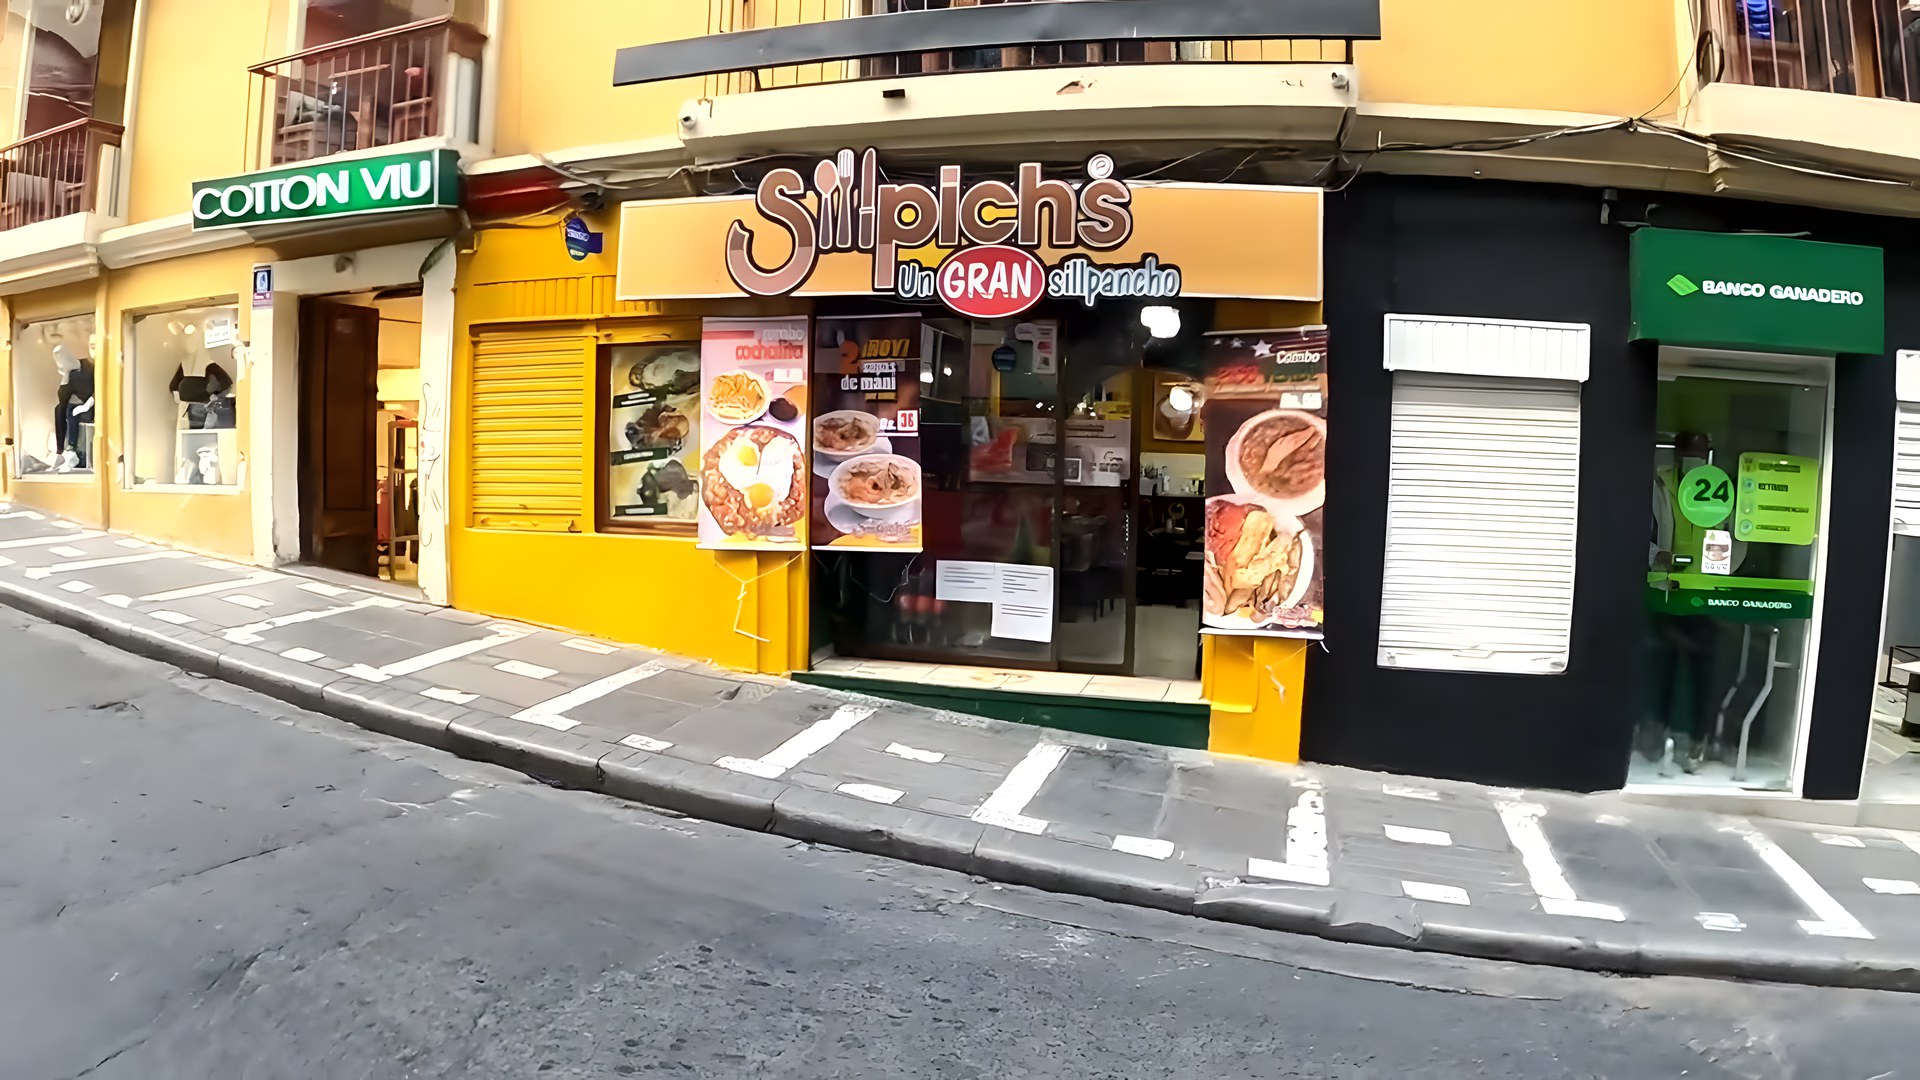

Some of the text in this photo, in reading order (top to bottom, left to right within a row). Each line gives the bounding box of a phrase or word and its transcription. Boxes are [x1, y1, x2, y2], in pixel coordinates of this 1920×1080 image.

[192, 159, 431, 220] COTTON VIU
[899, 257, 1179, 306] Un GRAN sillpancho
[1702, 280, 1864, 305] BANCO GANADERO
[1693, 478, 1729, 502] 24
